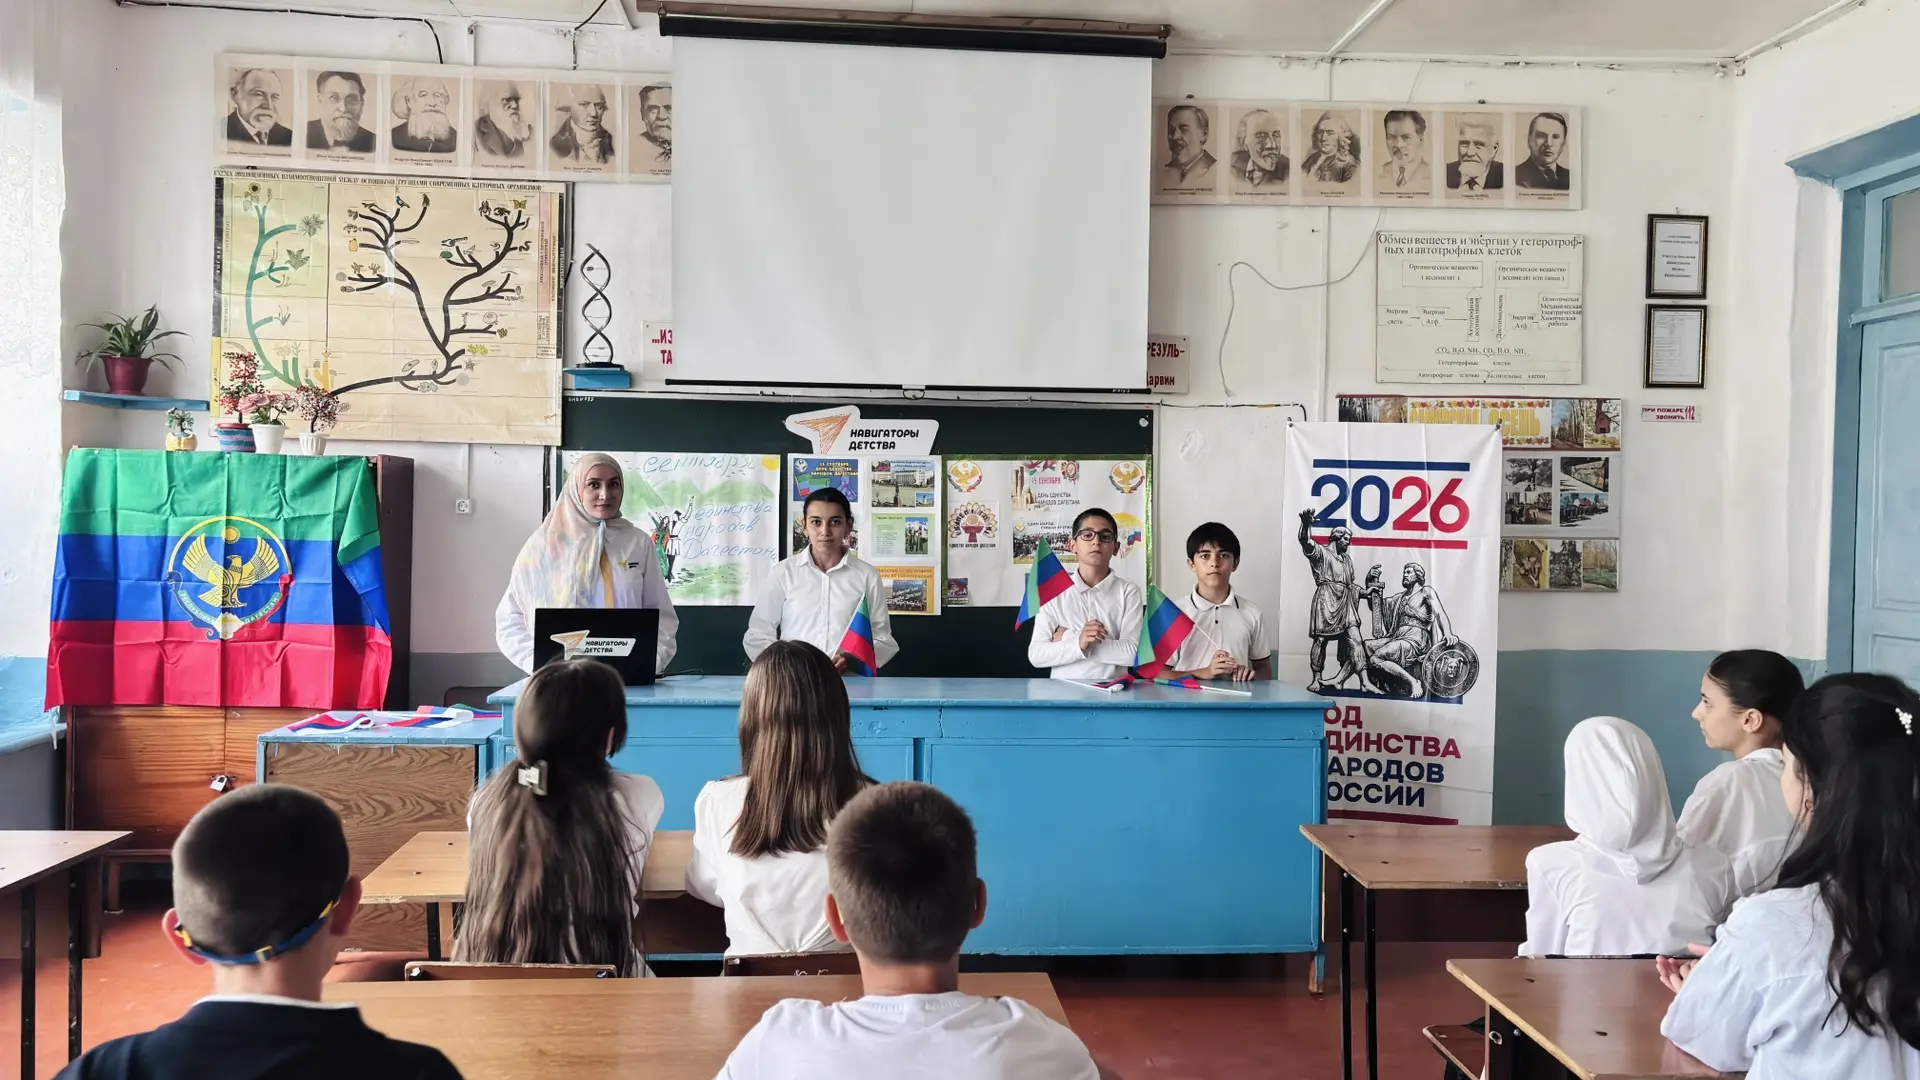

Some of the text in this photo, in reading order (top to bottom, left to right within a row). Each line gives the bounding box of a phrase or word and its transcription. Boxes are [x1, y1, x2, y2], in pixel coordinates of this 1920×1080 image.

[1379, 234, 1414, 245] Обмен
[1414, 237, 1457, 246] веществ
[1512, 238, 1519, 249] у
[1520, 236, 1582, 249] гетеротроф-
[1384, 246, 1405, 255] ных
[1414, 245, 1484, 258] автотрофных
[1487, 247, 1522, 256] клеток
[848, 441, 896, 450] ДЕТСТВА
[850, 429, 920, 438] НАВИГАТОРЫ
[1311, 474, 1470, 533] 2026
[1323, 705, 1363, 729] ОД
[1326, 730, 1461, 759] ДИНСТВА
[1327, 756, 1445, 783] АРОДОВ
[1327, 781, 1425, 807] ОССИИ
